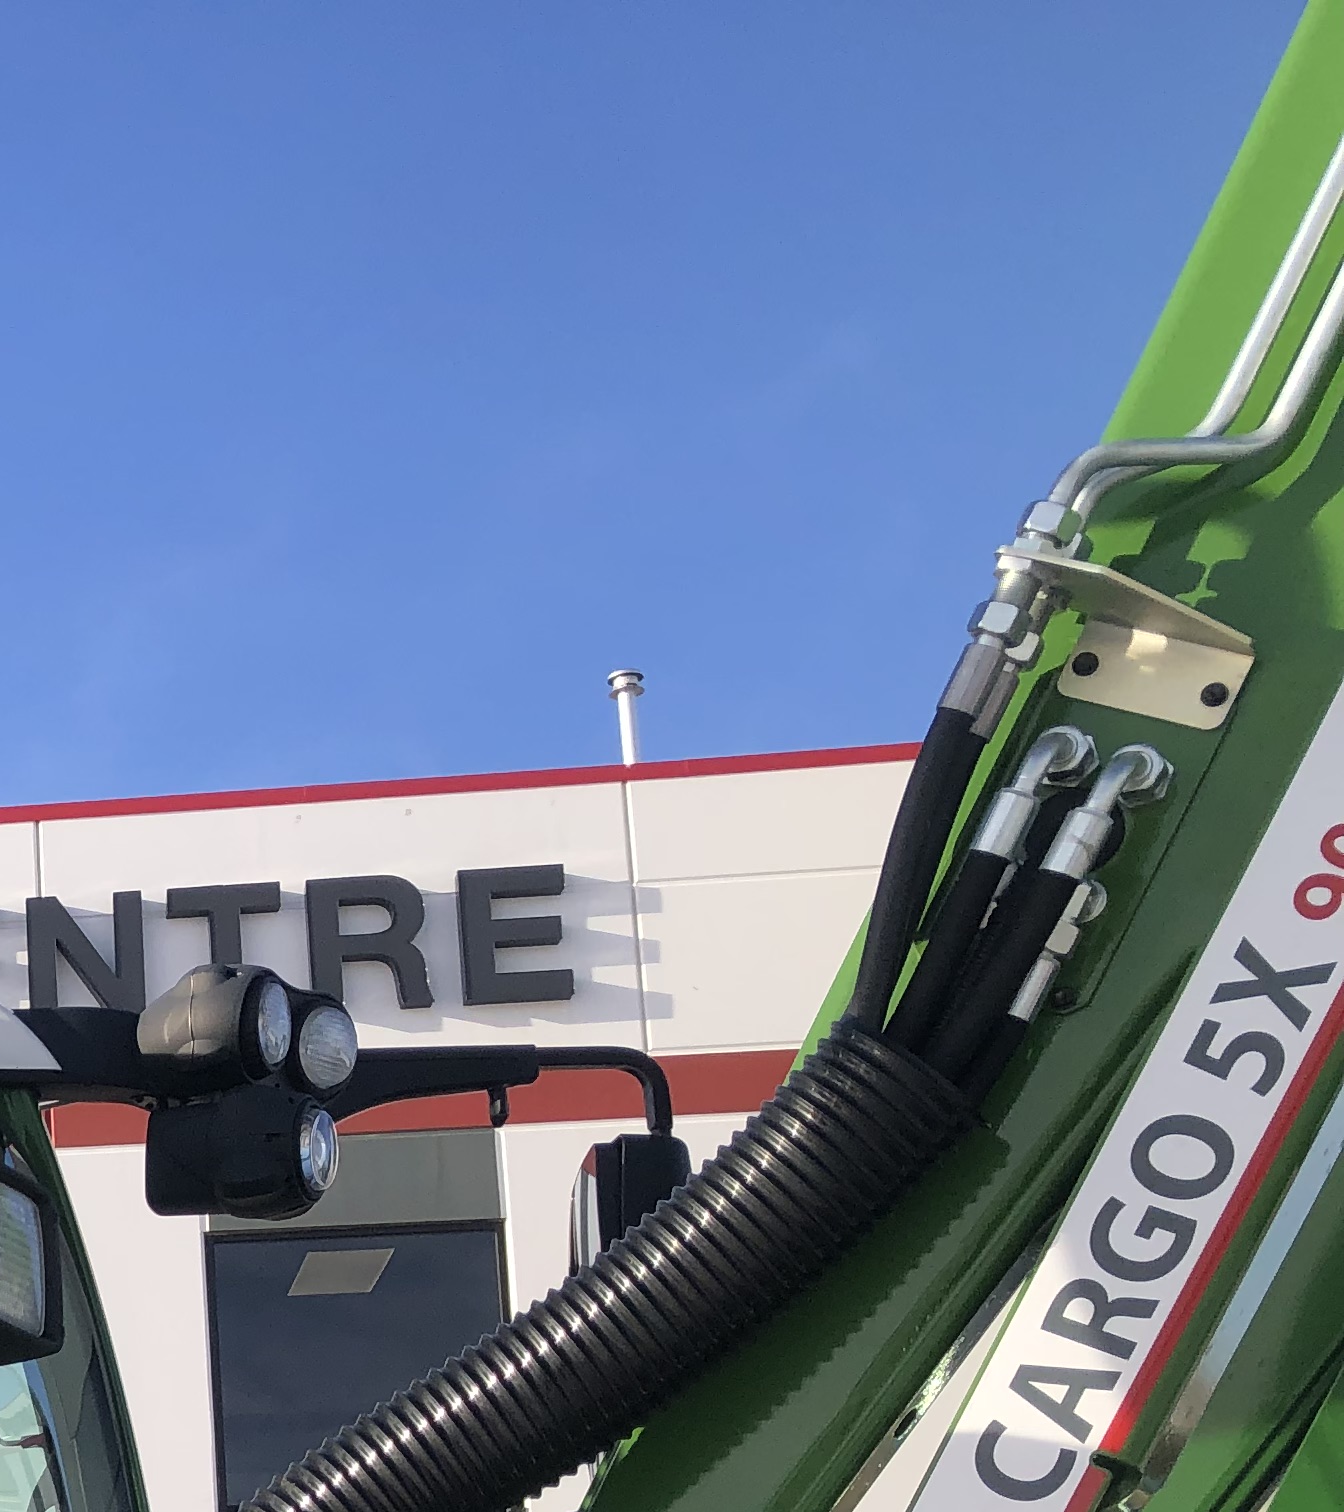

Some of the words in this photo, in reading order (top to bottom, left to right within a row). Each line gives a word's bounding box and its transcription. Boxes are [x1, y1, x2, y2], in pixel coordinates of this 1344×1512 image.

[974, 1113, 1235, 1502] CARGO
[1183, 935, 1337, 1098] 5X
[1293, 822, 1344, 921] 9
